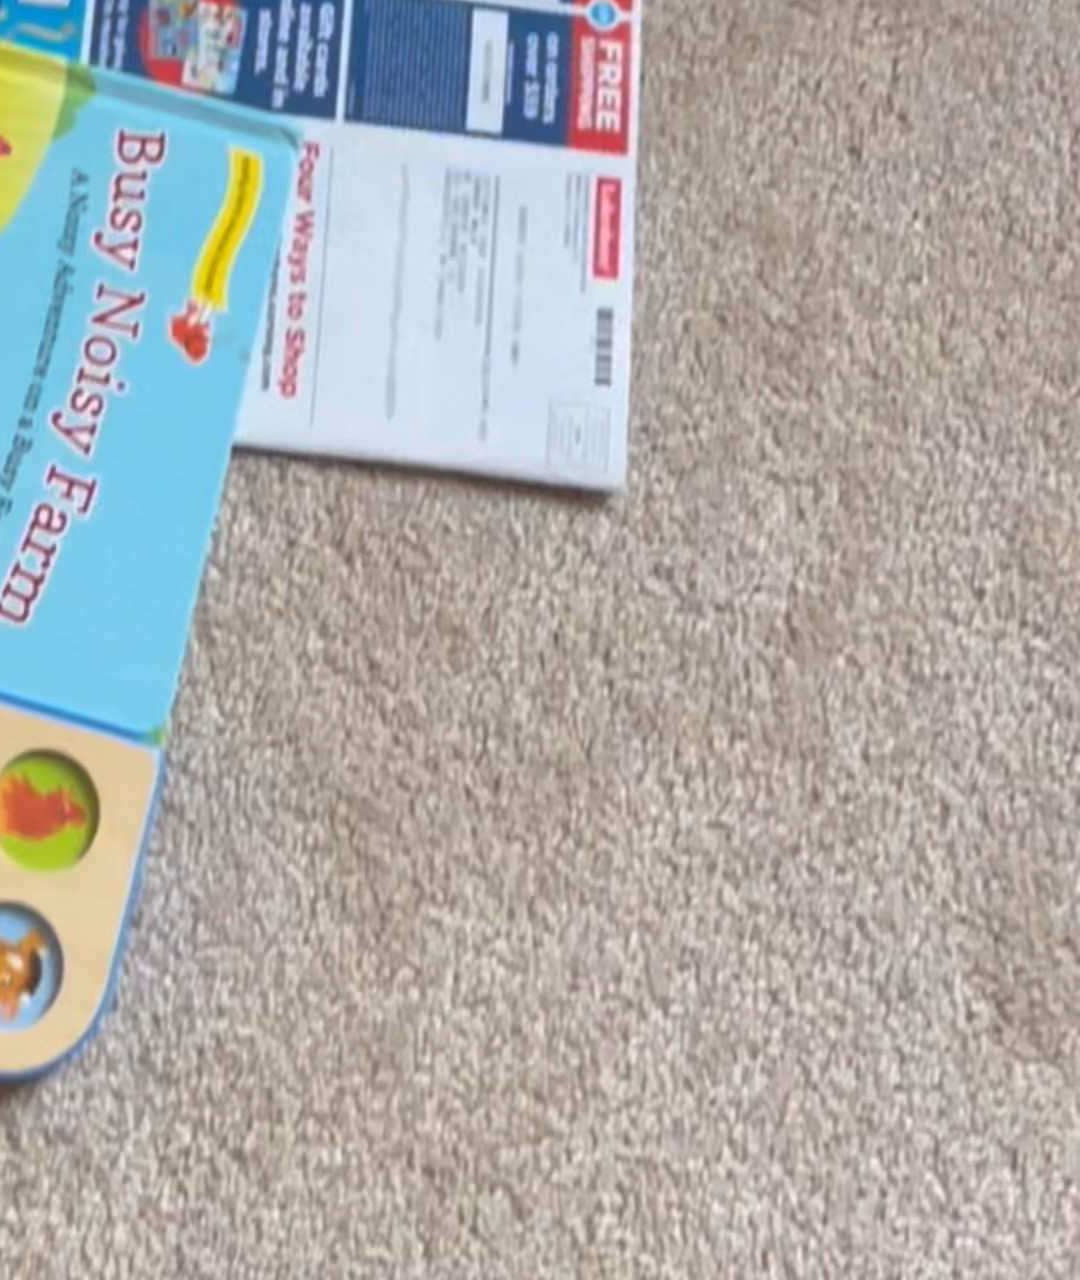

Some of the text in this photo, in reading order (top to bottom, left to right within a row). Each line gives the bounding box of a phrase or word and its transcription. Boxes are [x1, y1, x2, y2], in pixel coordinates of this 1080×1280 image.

[591, 38, 625, 133] FREE
[93, 129, 164, 272] Busy
[275, 139, 321, 402] Four Ways to Shop
[48, 281, 141, 459] Noisy
